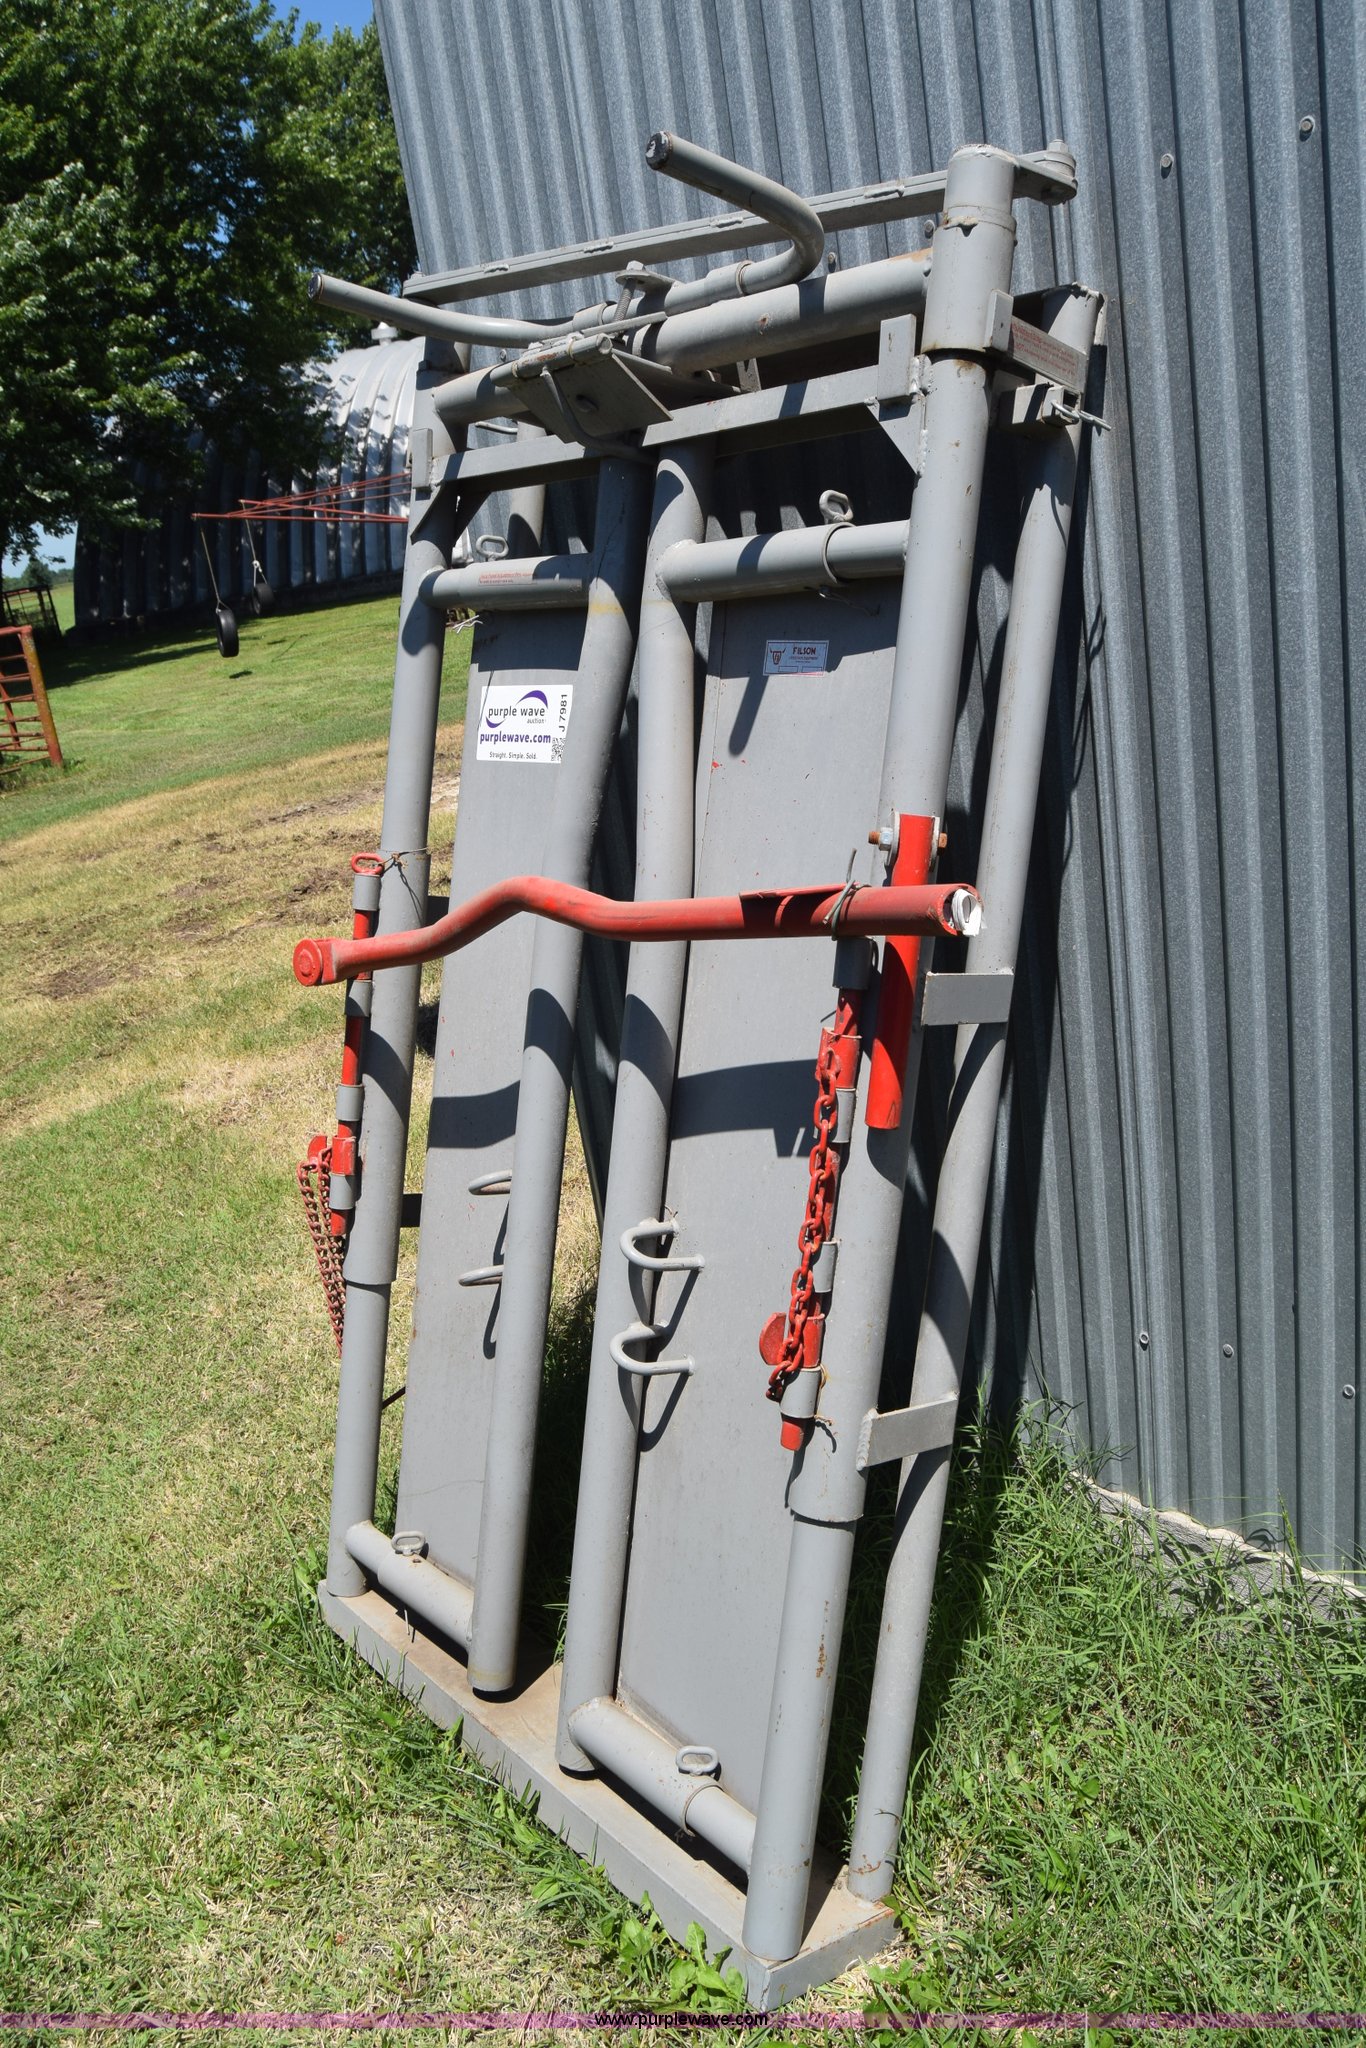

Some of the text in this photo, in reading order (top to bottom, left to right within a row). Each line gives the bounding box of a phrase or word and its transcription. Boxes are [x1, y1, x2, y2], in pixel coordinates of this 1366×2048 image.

[793, 647, 816, 655] FILSON
[488, 706, 545, 719] purple wave
[558, 694, 568, 733] J 7981
[480, 730, 551, 745] purplewave.com
[489, 751, 507, 760] Straight.
[508, 751, 525, 760] Simple.
